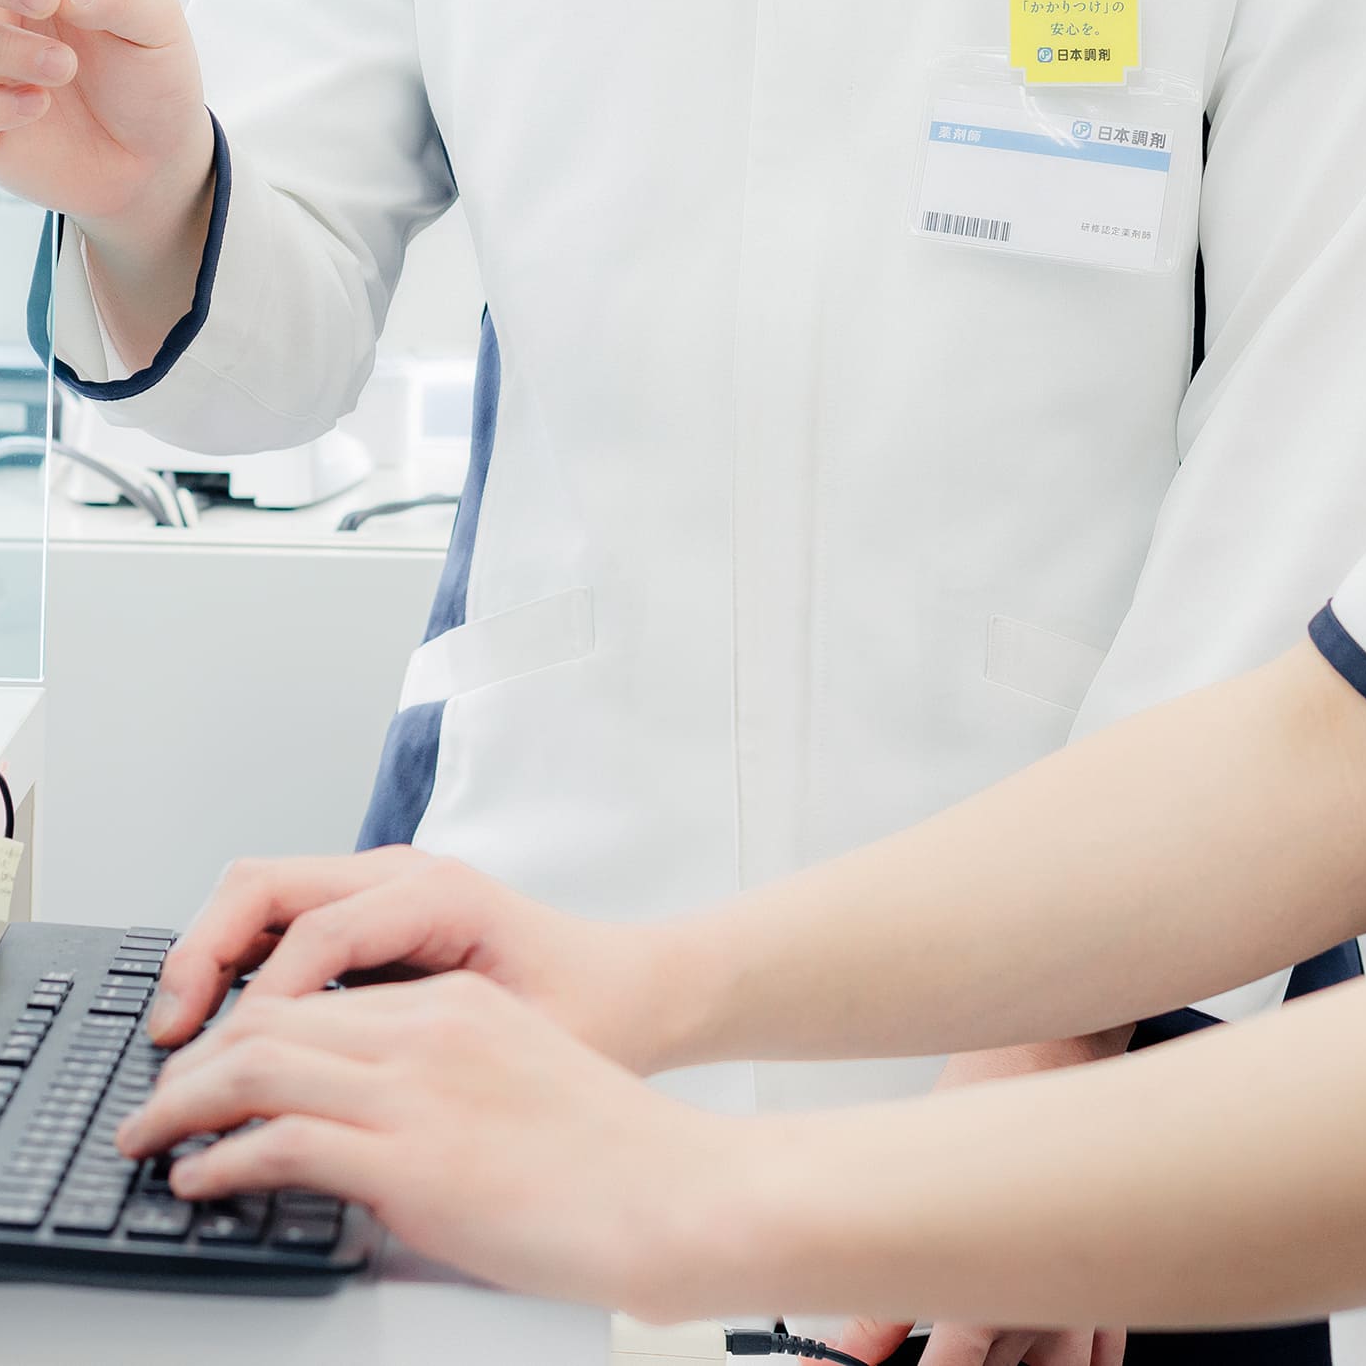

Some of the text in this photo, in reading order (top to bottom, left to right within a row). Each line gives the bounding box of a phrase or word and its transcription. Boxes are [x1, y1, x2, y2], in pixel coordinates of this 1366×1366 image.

[1023, 0, 1125, 14] 「かかりつけ」の
[1050, 23, 1100, 36] 安心を。
[1057, 48, 1111, 61] 日本調剤
[937, 125, 983, 143] 薬剤師
[1098, 125, 1167, 149] 日本調剤
